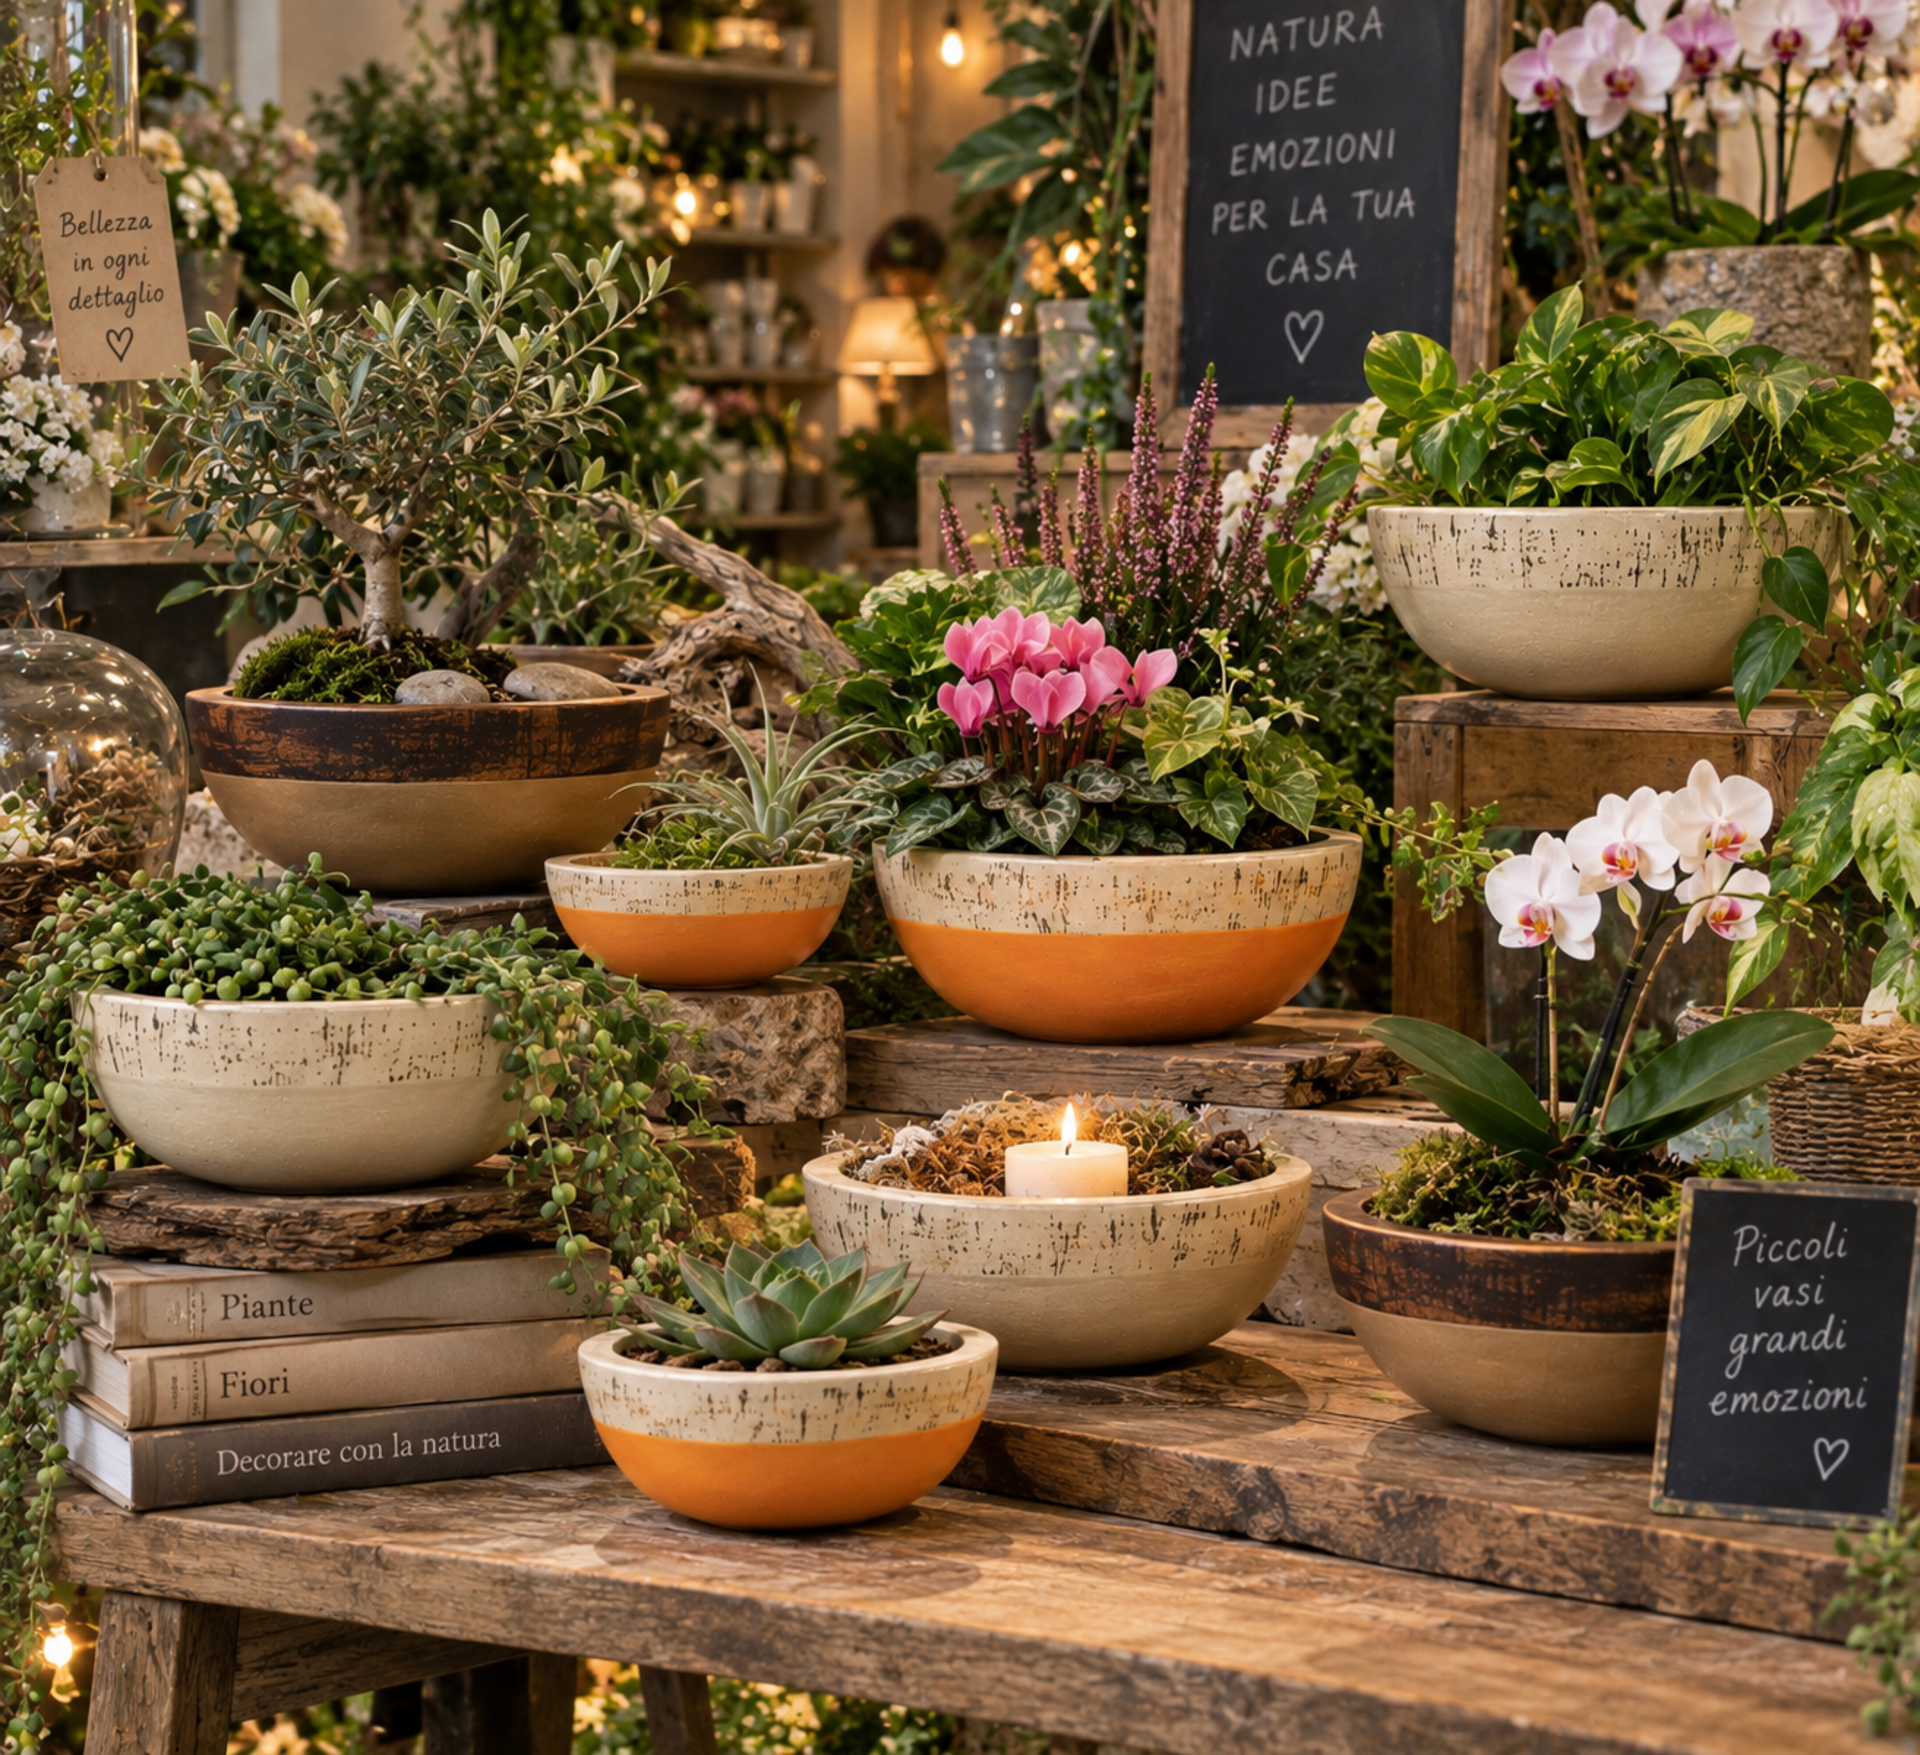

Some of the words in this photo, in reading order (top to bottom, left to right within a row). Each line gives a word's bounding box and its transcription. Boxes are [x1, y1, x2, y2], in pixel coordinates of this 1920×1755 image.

[1229, 5, 1384, 61] NATURA
[1254, 71, 1337, 114] IDEE
[1229, 127, 1395, 176] EMOZIONI
[59, 209, 152, 237] Bellezza
[1211, 198, 1268, 235] PER
[1289, 193, 1327, 227] LA
[1351, 186, 1415, 221] TUA
[73, 251, 93, 272] in
[103, 246, 149, 280] ogni
[1265, 248, 1358, 285] CASA
[68, 280, 164, 318] dettaglio
[1733, 1221, 1847, 1266] Piccoli
[220, 1291, 313, 1320] Piante
[1754, 1274, 1824, 1308] vasi
[1724, 1313, 1846, 1379] grandi
[219, 1367, 289, 1398] Fiori
[1708, 1376, 1867, 1415] emozioni
[216, 1446, 331, 1476] Decorare
[339, 1442, 383, 1463] con
[392, 1431, 413, 1458] la
[422, 1429, 500, 1455] natura
